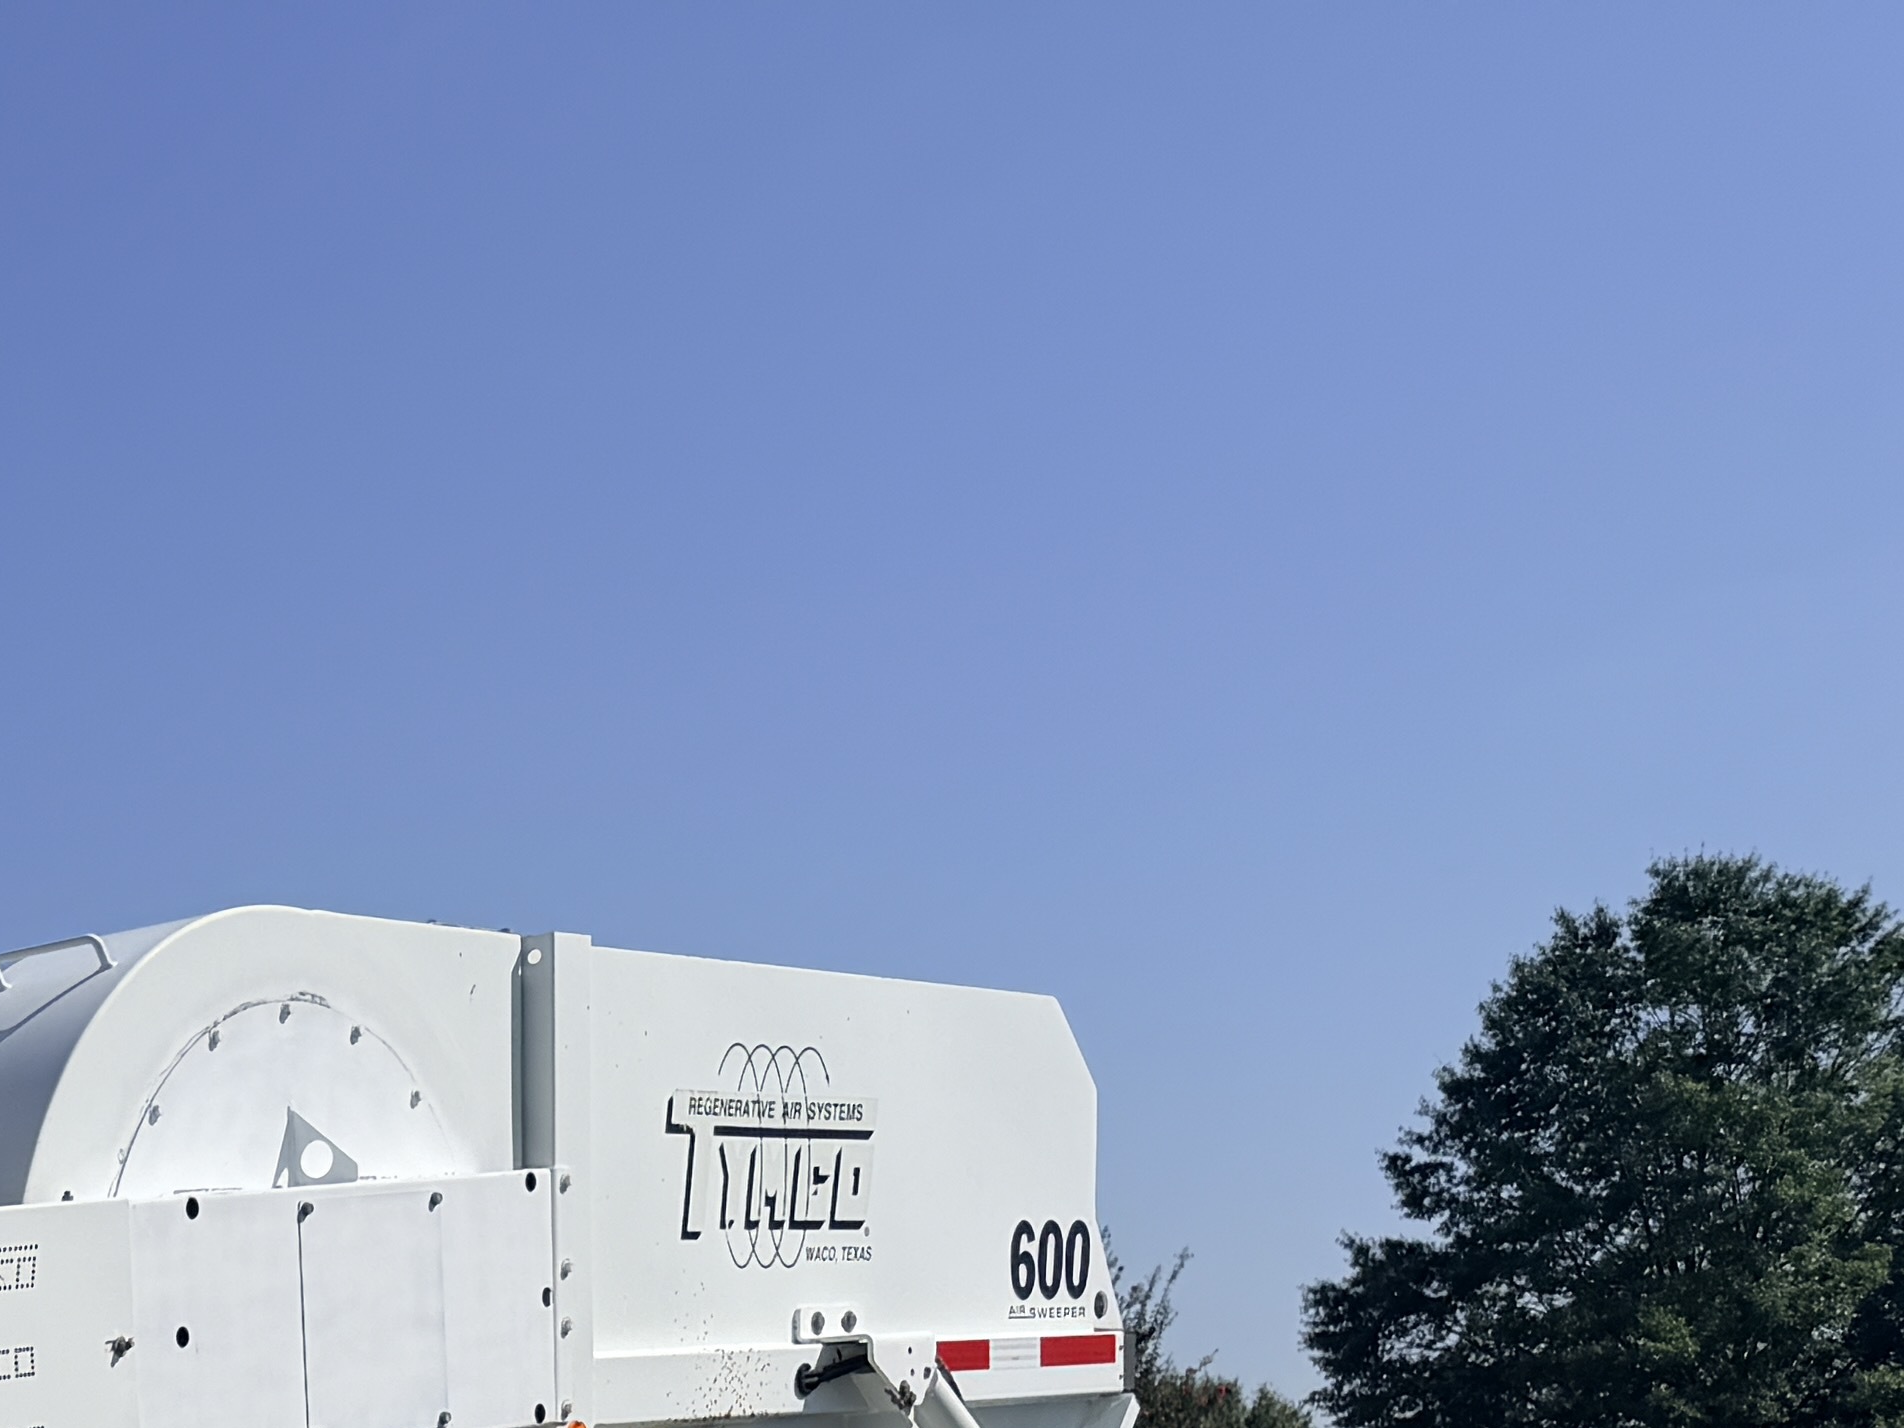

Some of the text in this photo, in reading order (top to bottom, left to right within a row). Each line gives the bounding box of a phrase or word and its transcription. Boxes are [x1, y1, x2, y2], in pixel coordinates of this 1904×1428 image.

[688, 1096, 864, 1122] REGENERATIVE AIR SYSTEMS
[805, 1246, 873, 1264] WACO, TEXAS
[1010, 1219, 1091, 1301] 600
[1008, 1305, 1086, 1319] AIR SWEEPER
